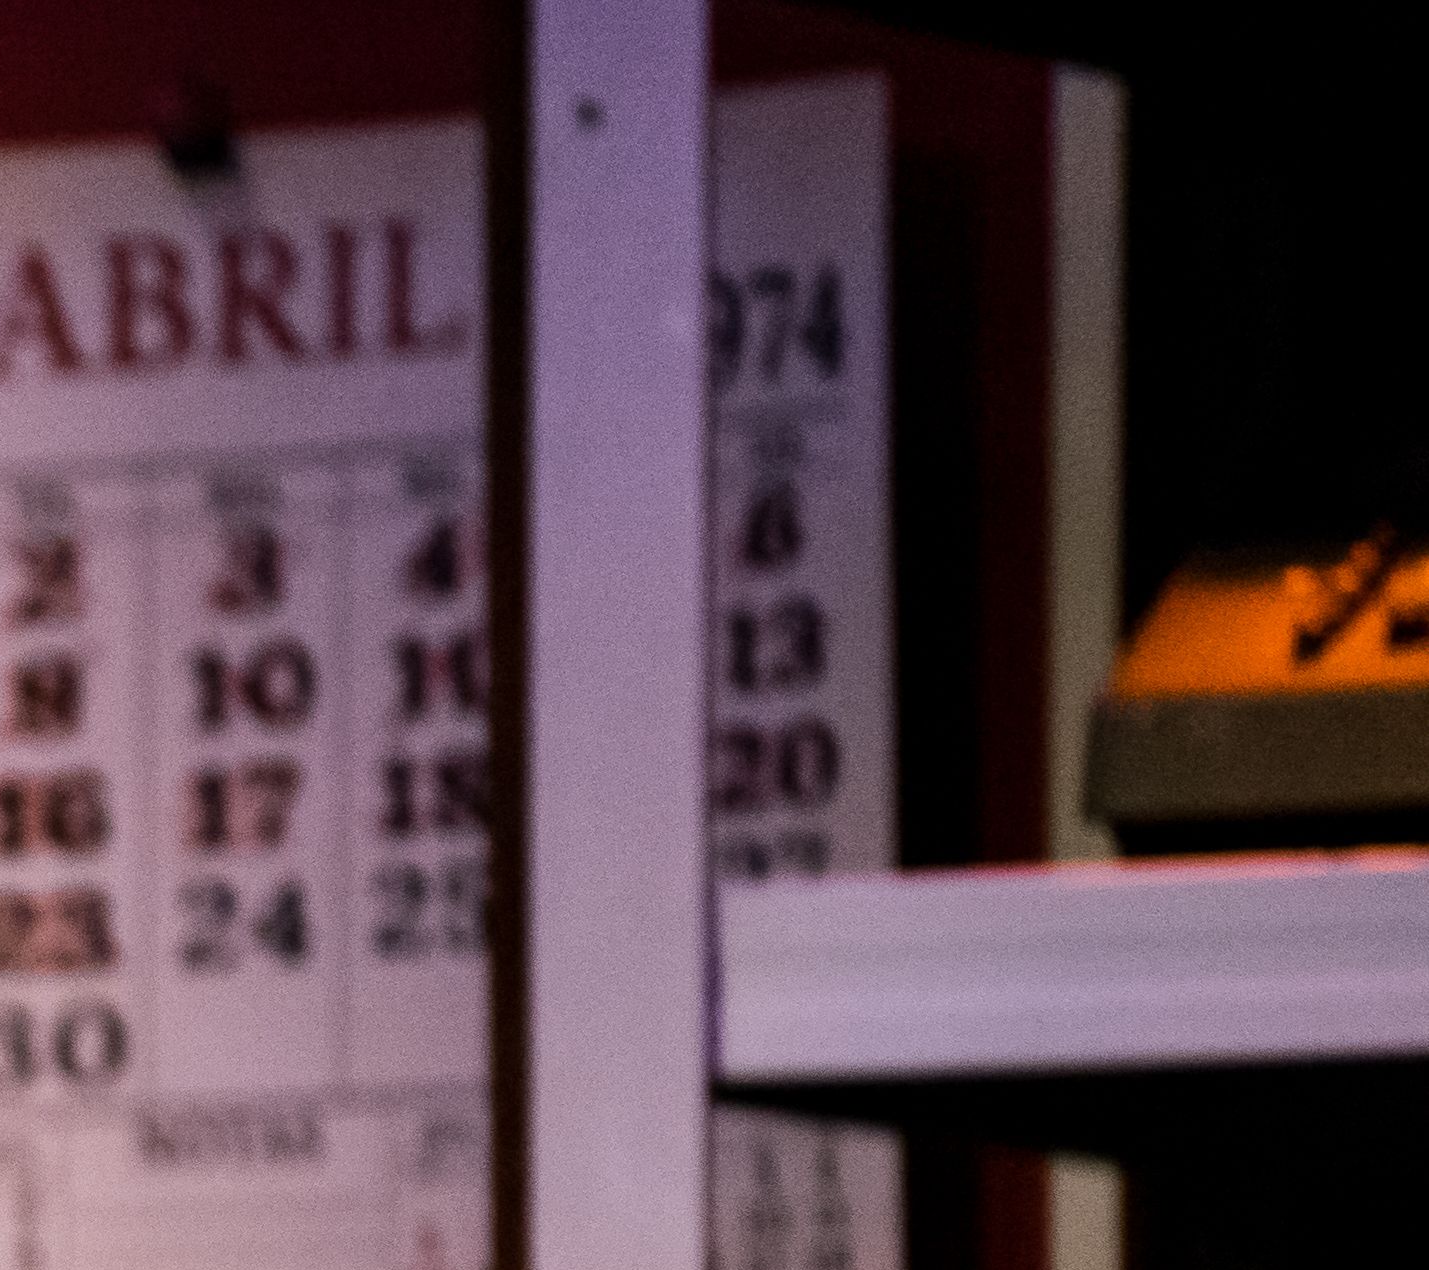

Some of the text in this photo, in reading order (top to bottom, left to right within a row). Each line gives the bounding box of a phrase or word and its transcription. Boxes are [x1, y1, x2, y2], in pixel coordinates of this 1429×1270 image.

[710, 262, 843, 392] 974
[188, 636, 318, 736] 10
[726, 597, 826, 692] 13
[183, 754, 302, 856] 17
[179, 878, 311, 980] 24
